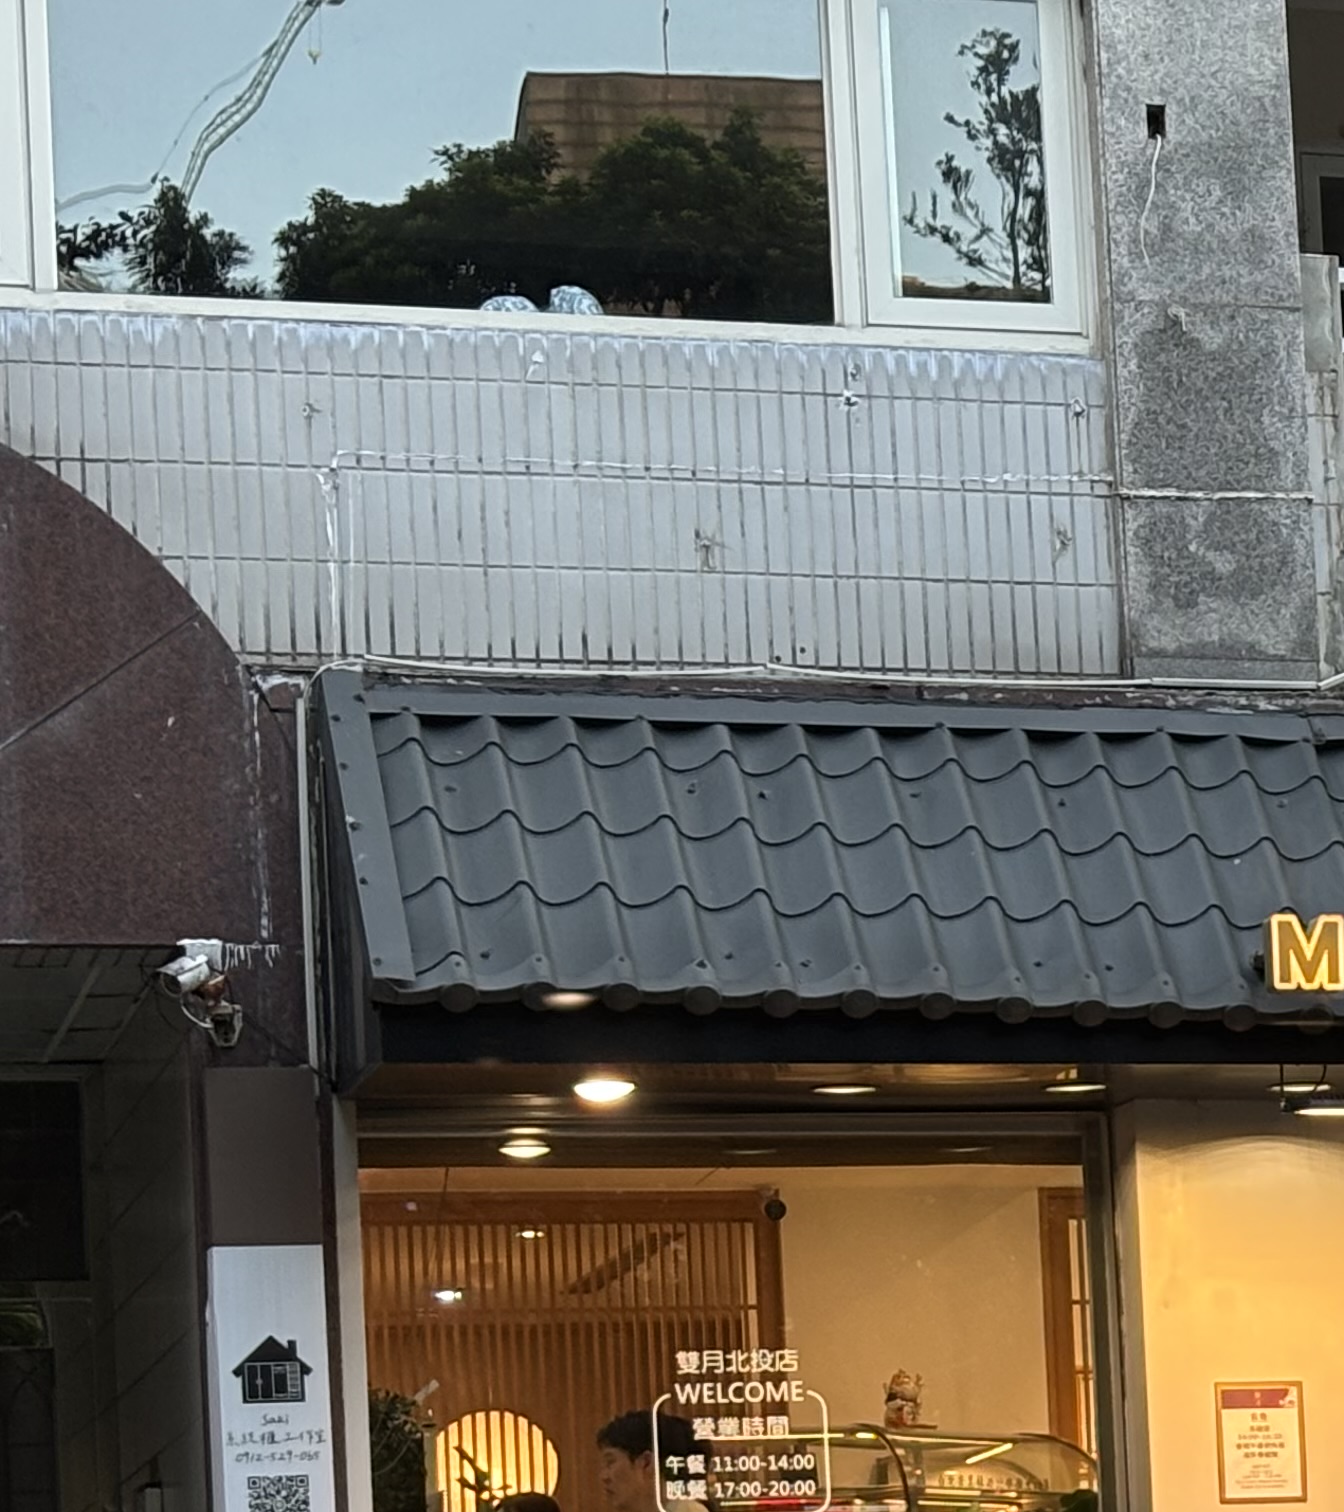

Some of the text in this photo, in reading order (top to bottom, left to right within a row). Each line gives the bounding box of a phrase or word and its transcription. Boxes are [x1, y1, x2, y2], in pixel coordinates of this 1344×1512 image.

[675, 1348, 799, 1375] 雙月北投店
[674, 1380, 805, 1405] WELCOME
[692, 1415, 790, 1441] 營業時間
[665, 1453, 815, 1475] 午餐 11:00-14:00
[714, 1479, 816, 1499] 17:00-20:00
